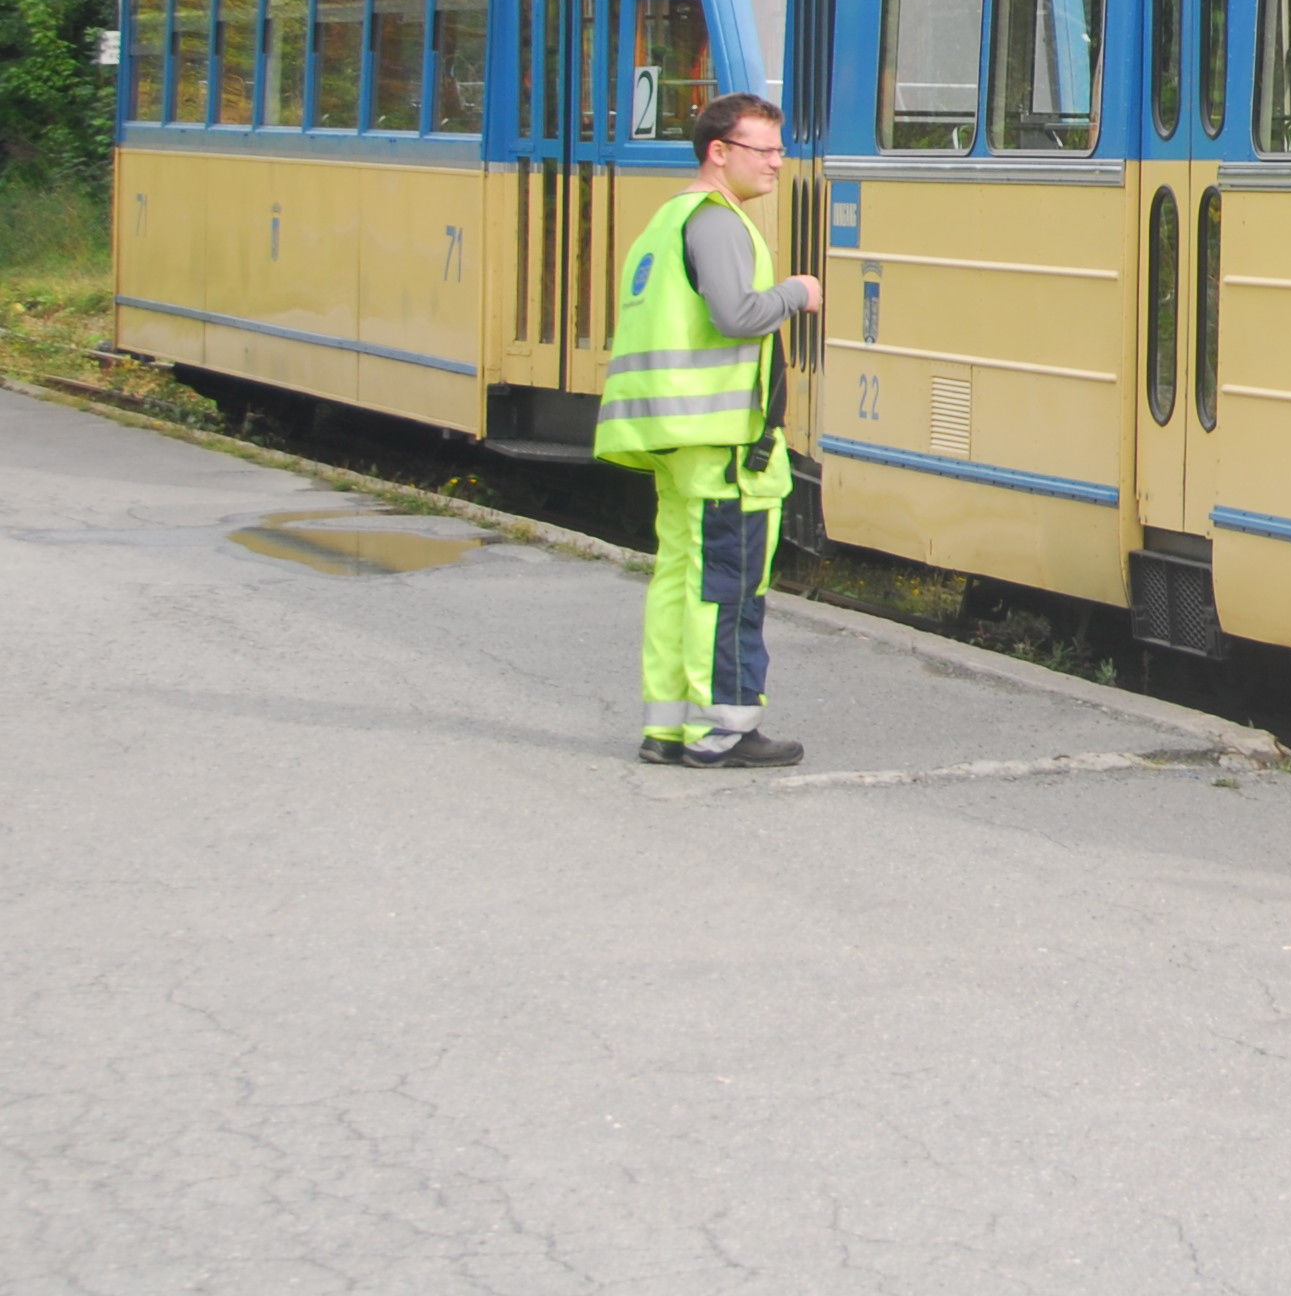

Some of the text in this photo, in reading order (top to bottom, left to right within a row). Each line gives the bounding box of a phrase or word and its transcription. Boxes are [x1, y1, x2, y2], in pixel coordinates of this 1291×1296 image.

[634, 70, 654, 135] 2
[444, 225, 463, 283] 71
[859, 374, 880, 420] 22
